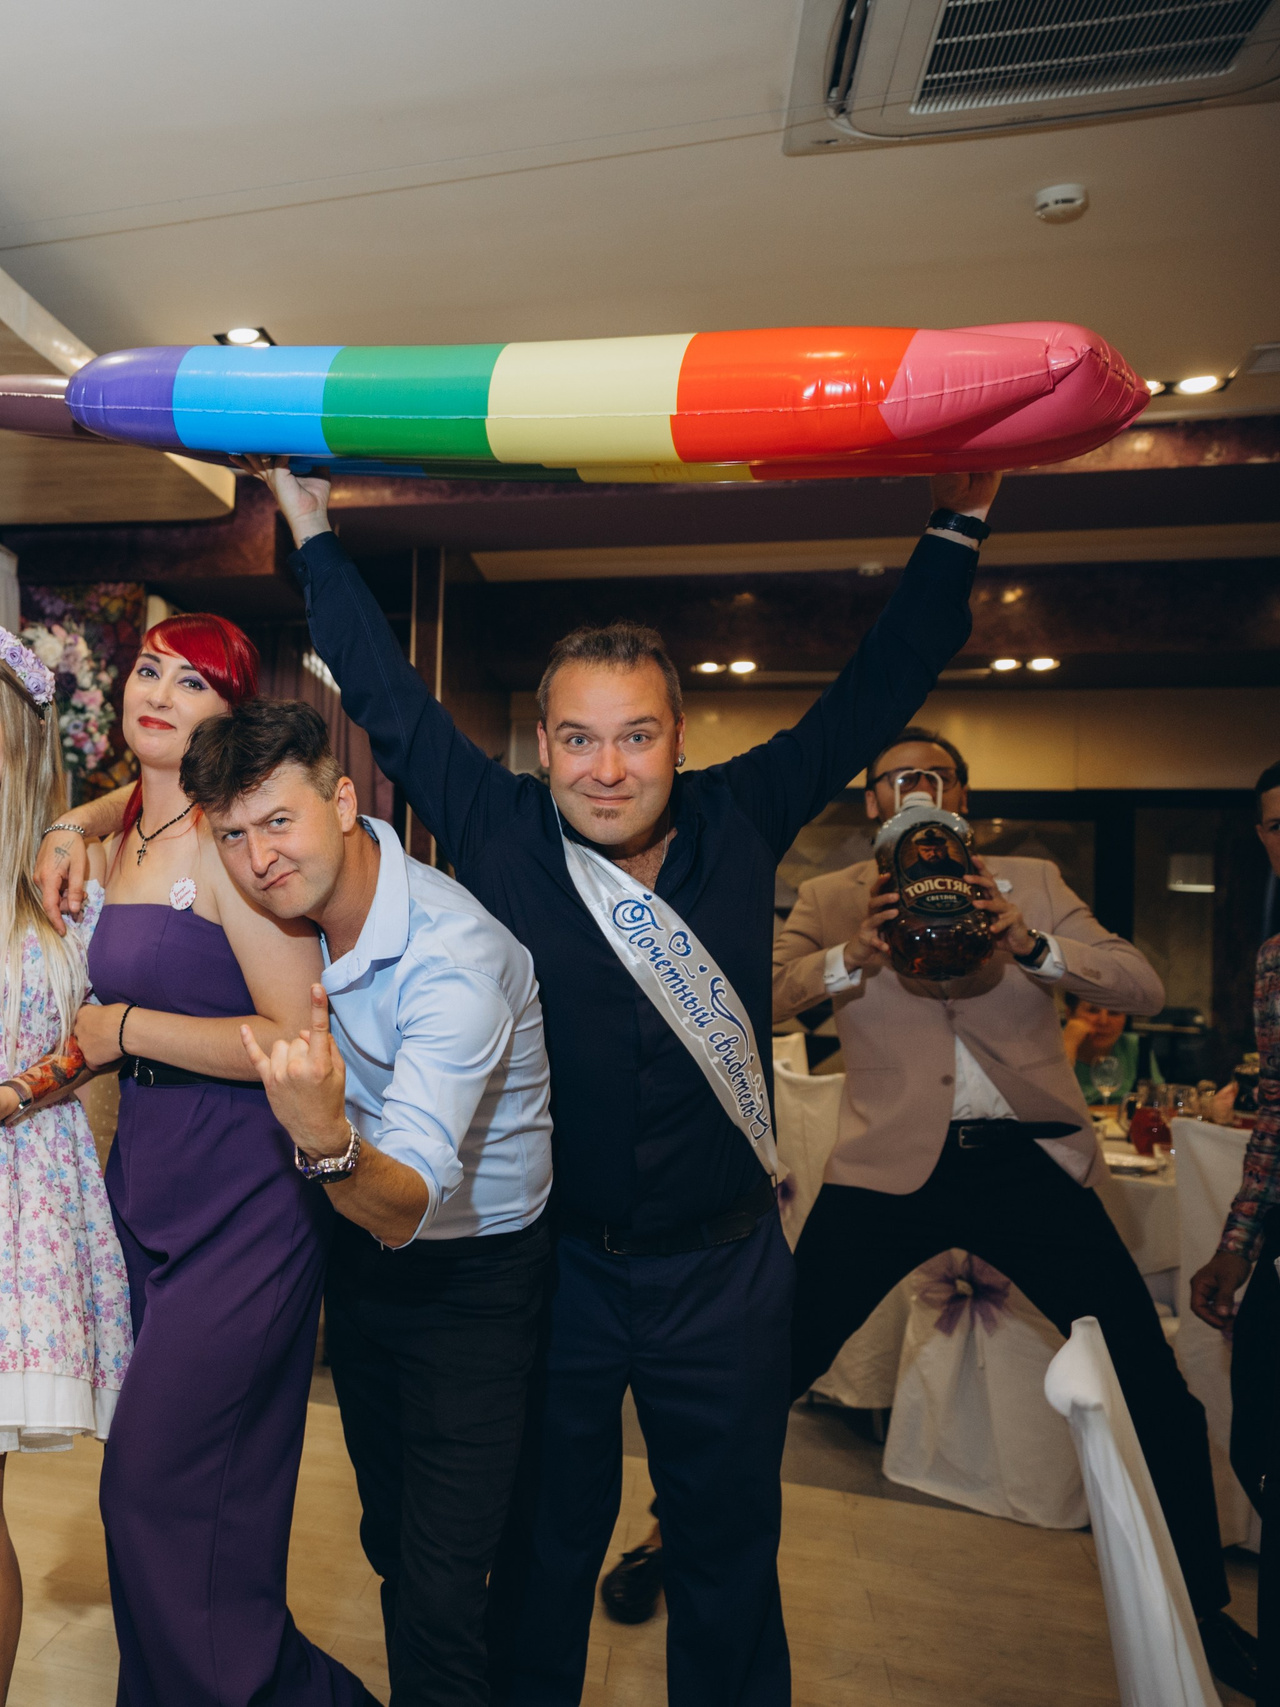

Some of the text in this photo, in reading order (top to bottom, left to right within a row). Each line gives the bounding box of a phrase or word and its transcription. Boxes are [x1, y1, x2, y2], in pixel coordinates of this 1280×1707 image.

[905, 878, 972, 897] ТОЛСТЯК
[612, 899, 756, 1118] Почетный свидетель
